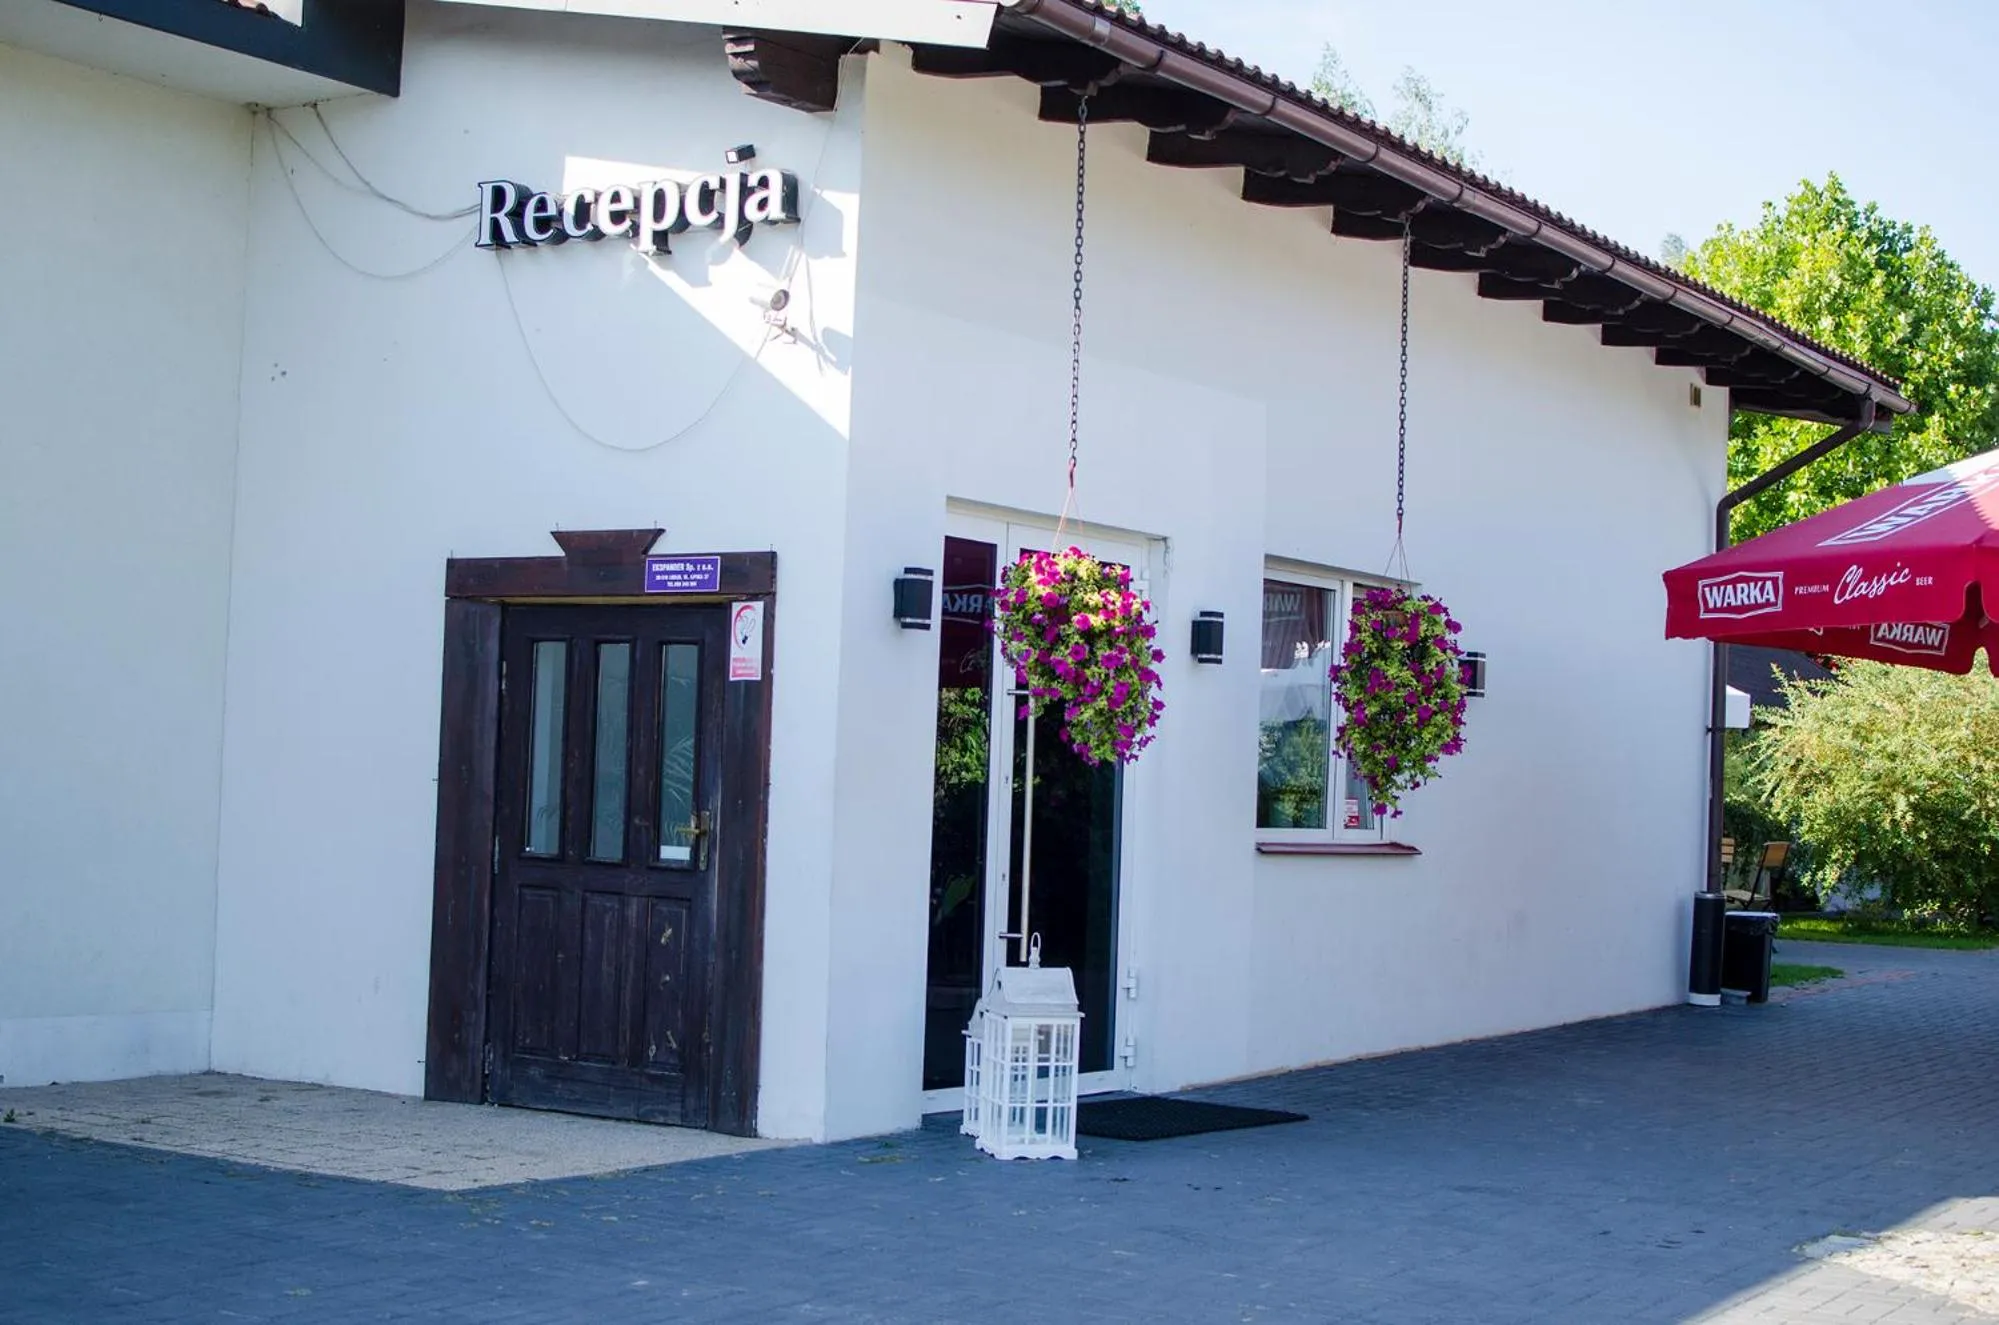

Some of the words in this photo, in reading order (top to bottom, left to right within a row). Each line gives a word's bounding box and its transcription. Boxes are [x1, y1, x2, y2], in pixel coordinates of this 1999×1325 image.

[475, 149, 797, 255] Recepcja
[1704, 579, 1777, 609] WARKA
[1794, 584, 1830, 595] PREMIUM
[1833, 561, 1912, 604] Classic
[1915, 576, 1933, 586] BEER
